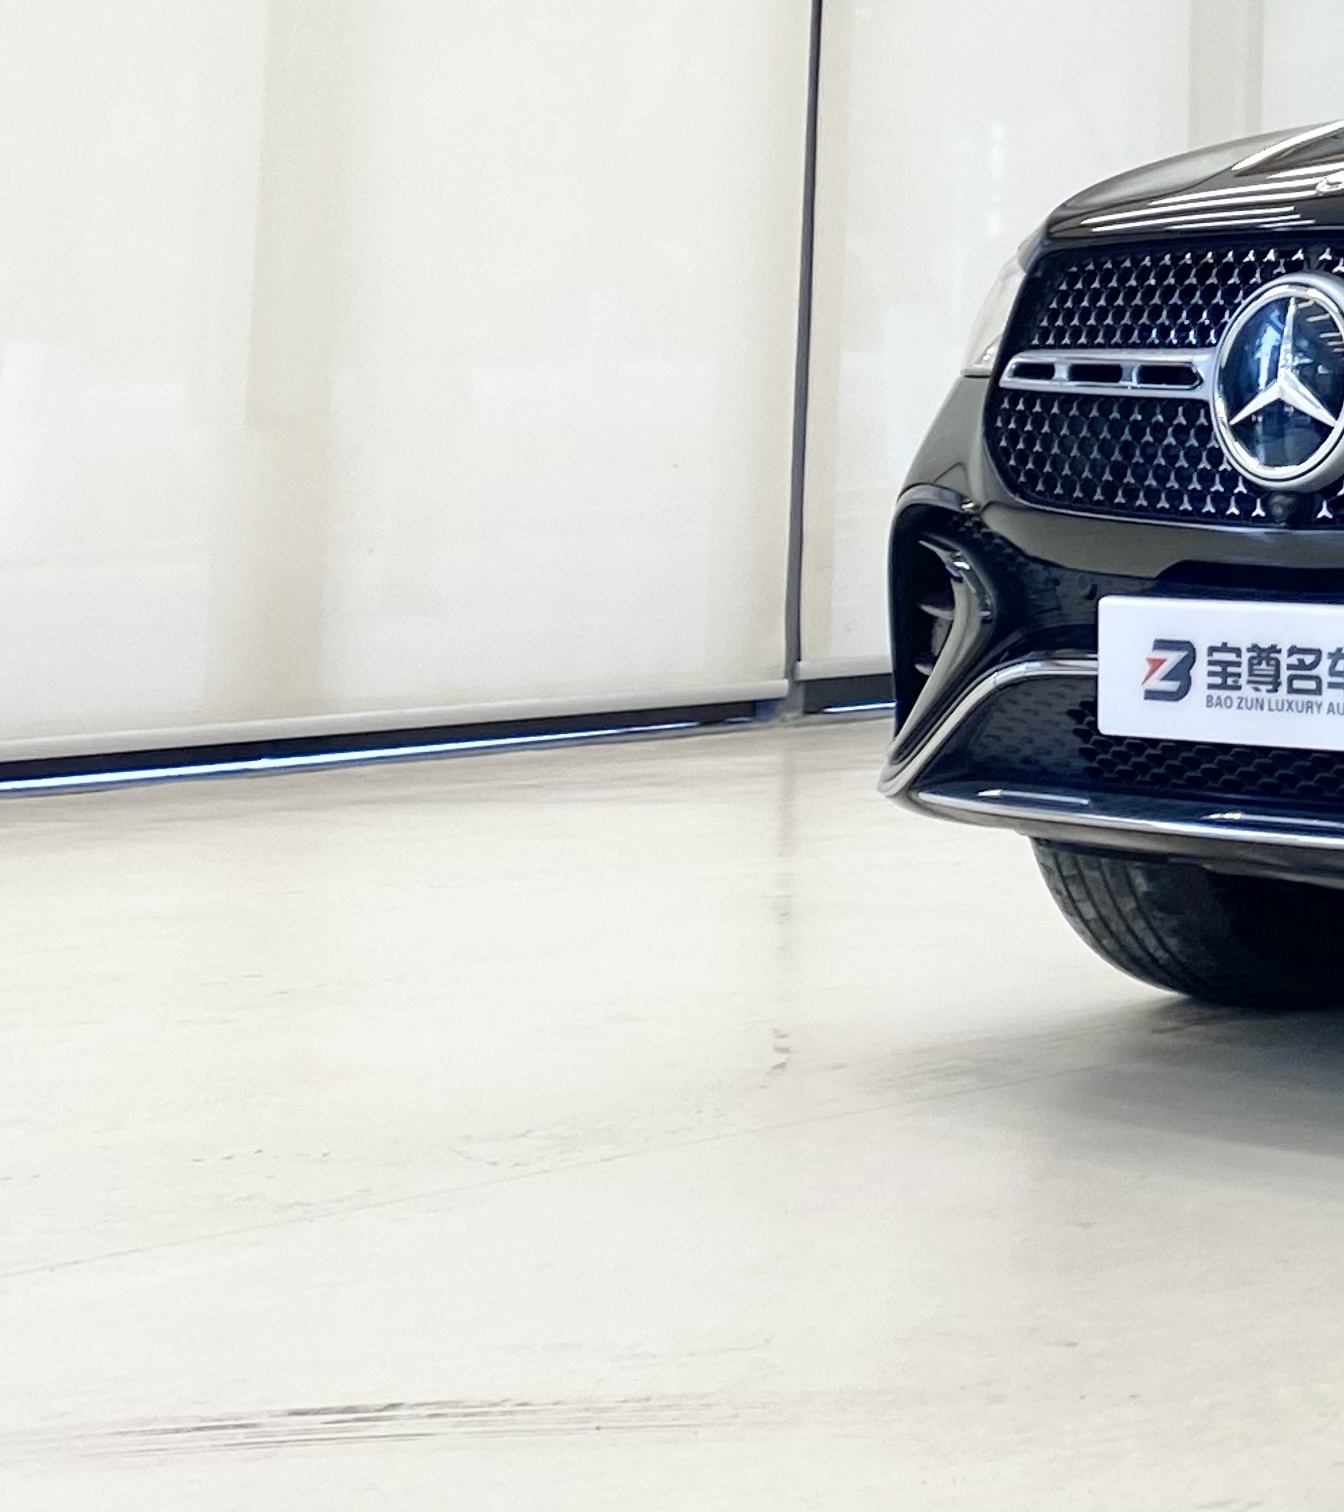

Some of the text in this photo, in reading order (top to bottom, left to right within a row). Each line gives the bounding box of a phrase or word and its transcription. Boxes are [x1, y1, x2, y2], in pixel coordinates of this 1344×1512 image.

[1205, 694, 1233, 709] BAO
[1236, 696, 1264, 711] ZUN
[1267, 698, 1323, 714] LUXURY
